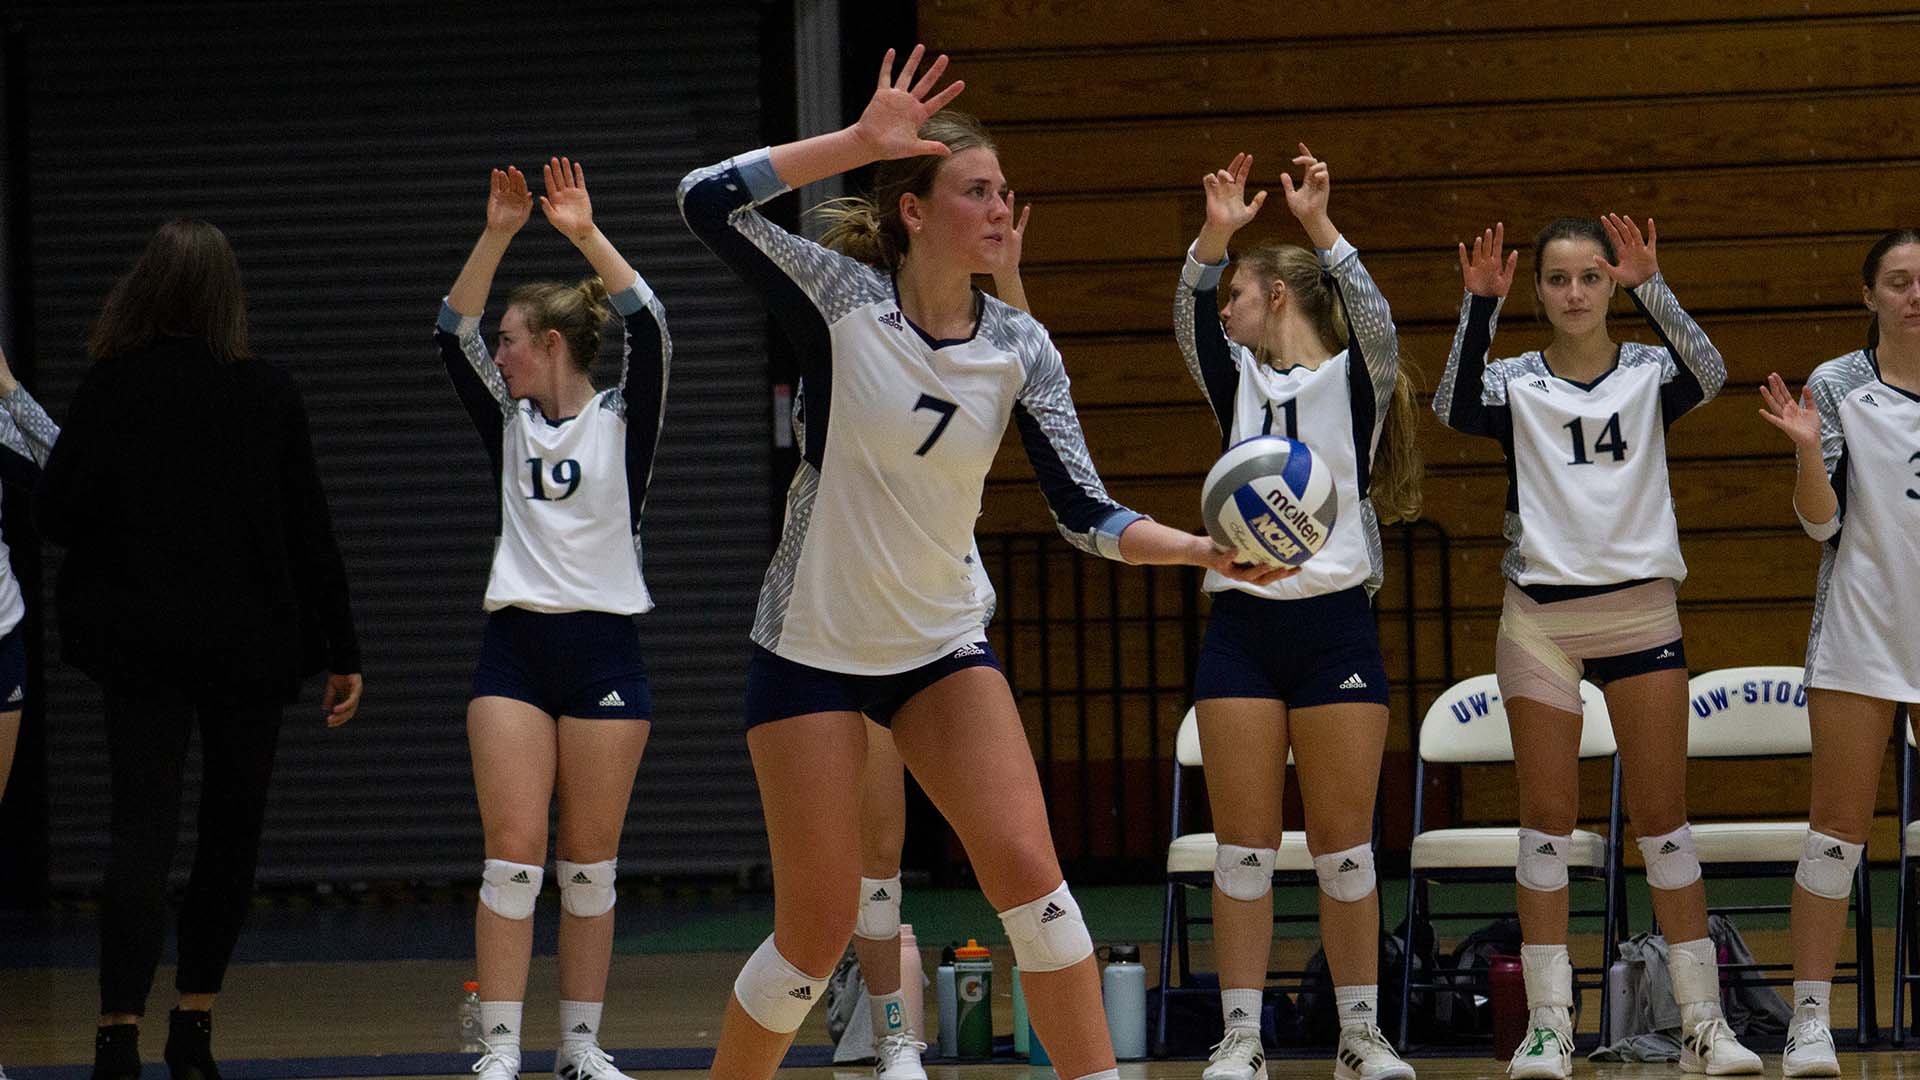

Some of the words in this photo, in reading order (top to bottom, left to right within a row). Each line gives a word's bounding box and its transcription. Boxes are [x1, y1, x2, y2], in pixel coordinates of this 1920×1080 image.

[878, 316, 903, 331] adidas
[913, 393, 959, 456] 7
[1563, 412, 1627, 465] 14
[526, 457, 581, 501] 19
[1249, 513, 1302, 560] NCAA
[1267, 489, 1320, 546] molten
[1041, 909, 1066, 923] adidas
